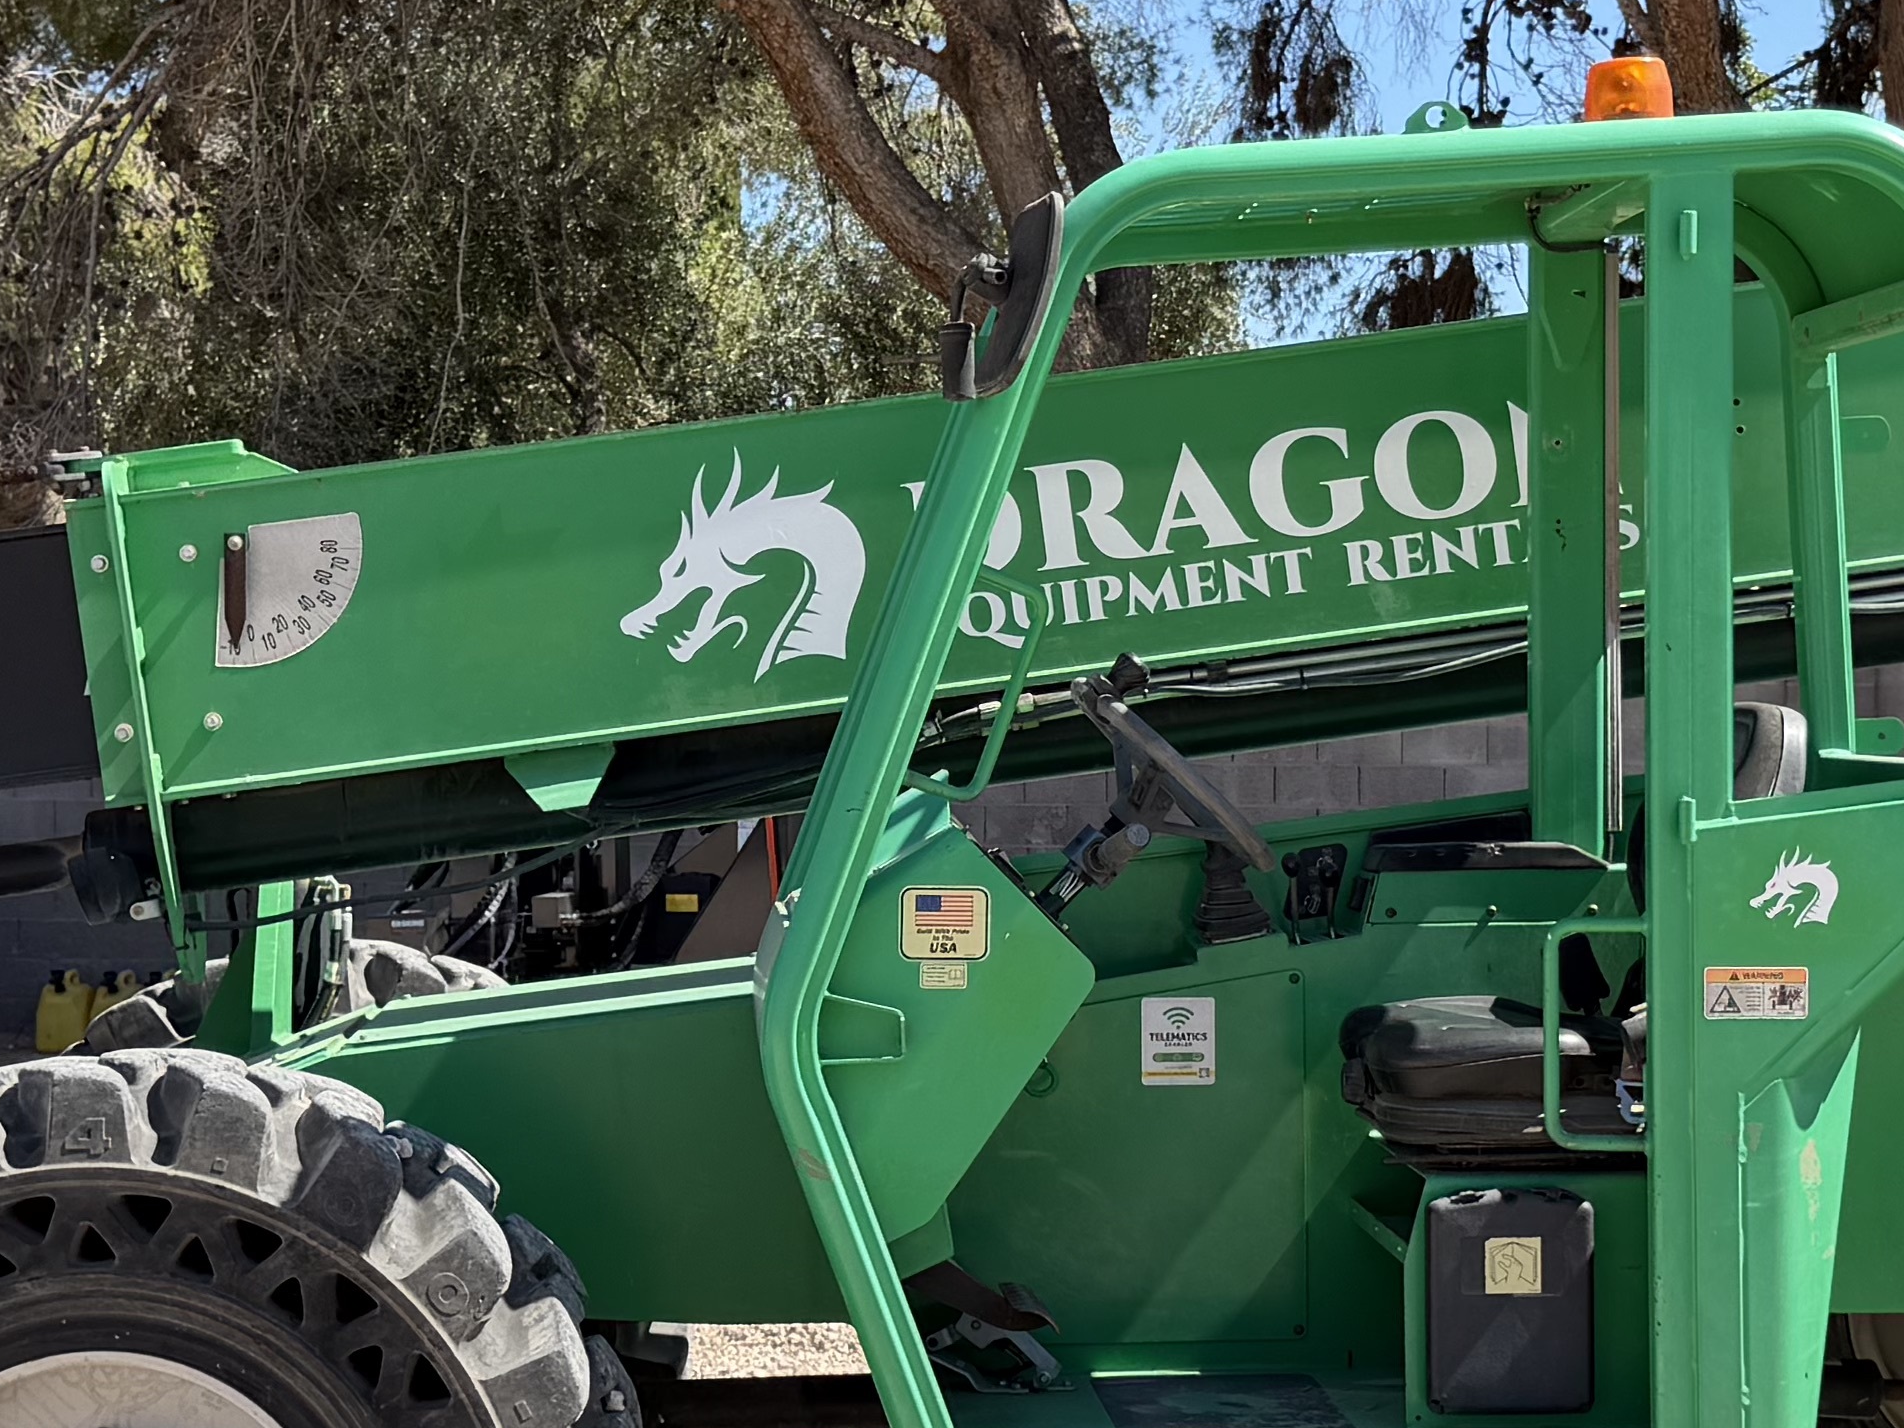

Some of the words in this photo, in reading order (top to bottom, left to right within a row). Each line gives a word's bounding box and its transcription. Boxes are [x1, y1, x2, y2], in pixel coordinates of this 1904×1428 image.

[319, 539, 338, 554] 80
[330, 556, 350, 572] 70
[313, 569, 333, 586] 60
[958, 546, 1312, 649] QUIPMENT
[1343, 503, 1641, 586] RENTS
[297, 594, 316, 612] 40
[316, 589, 337, 608] 50
[271, 613, 289, 633] 20
[292, 615, 312, 635] 30
[246, 623, 255, 642] 0
[261, 632, 277, 651] 10
[929, 942, 957, 953] USA
[1149, 1032, 1208, 1042] TELEMATICS
